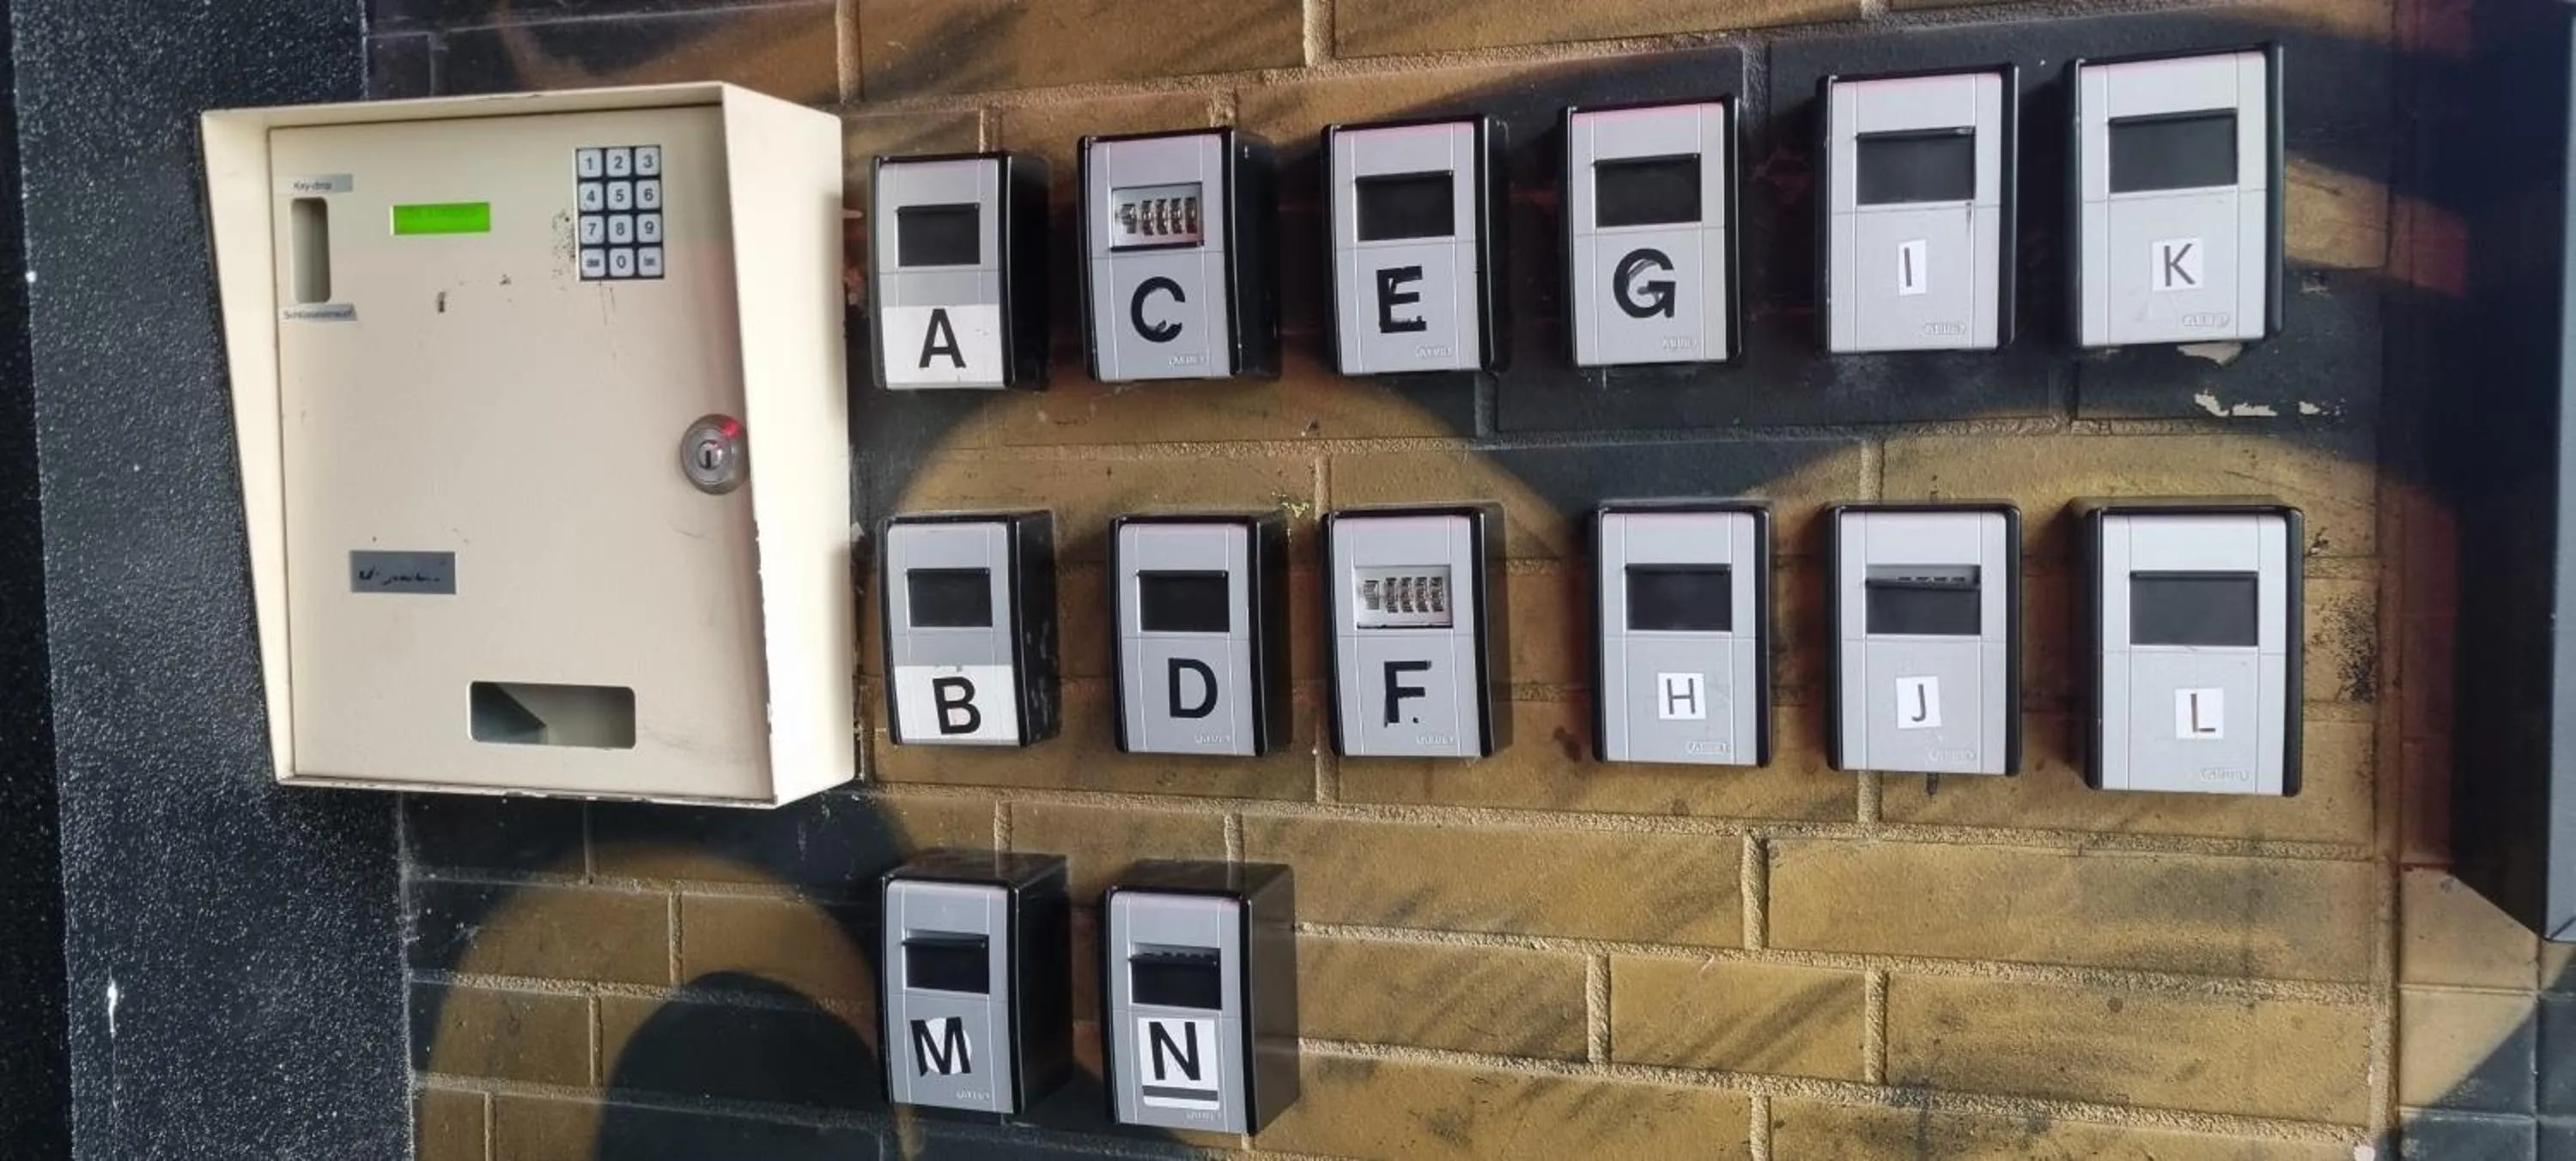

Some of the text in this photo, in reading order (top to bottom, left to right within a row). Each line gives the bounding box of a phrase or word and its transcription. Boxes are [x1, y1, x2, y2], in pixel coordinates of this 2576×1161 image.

[586, 153, 654, 171] 1 2 3
[586, 186, 654, 204] 4 5 6
[587, 220, 655, 237] 7 8 9
[615, 253, 628, 270] 0
[1613, 249, 1676, 318] G
[1905, 247, 1911, 287] I
[2165, 244, 2195, 287] K
[1131, 277, 1185, 343] C
[1376, 266, 1426, 333] E
[920, 308, 966, 368] A
[933, 677, 981, 734] B
[1168, 658, 1218, 718] D
[1384, 660, 1431, 726] F
[1667, 678, 1695, 714] H
[1912, 684, 1926, 722] J
[2190, 694, 2215, 732] L
[910, 1017, 971, 1077] M
[1149, 1022, 1200, 1080] N
